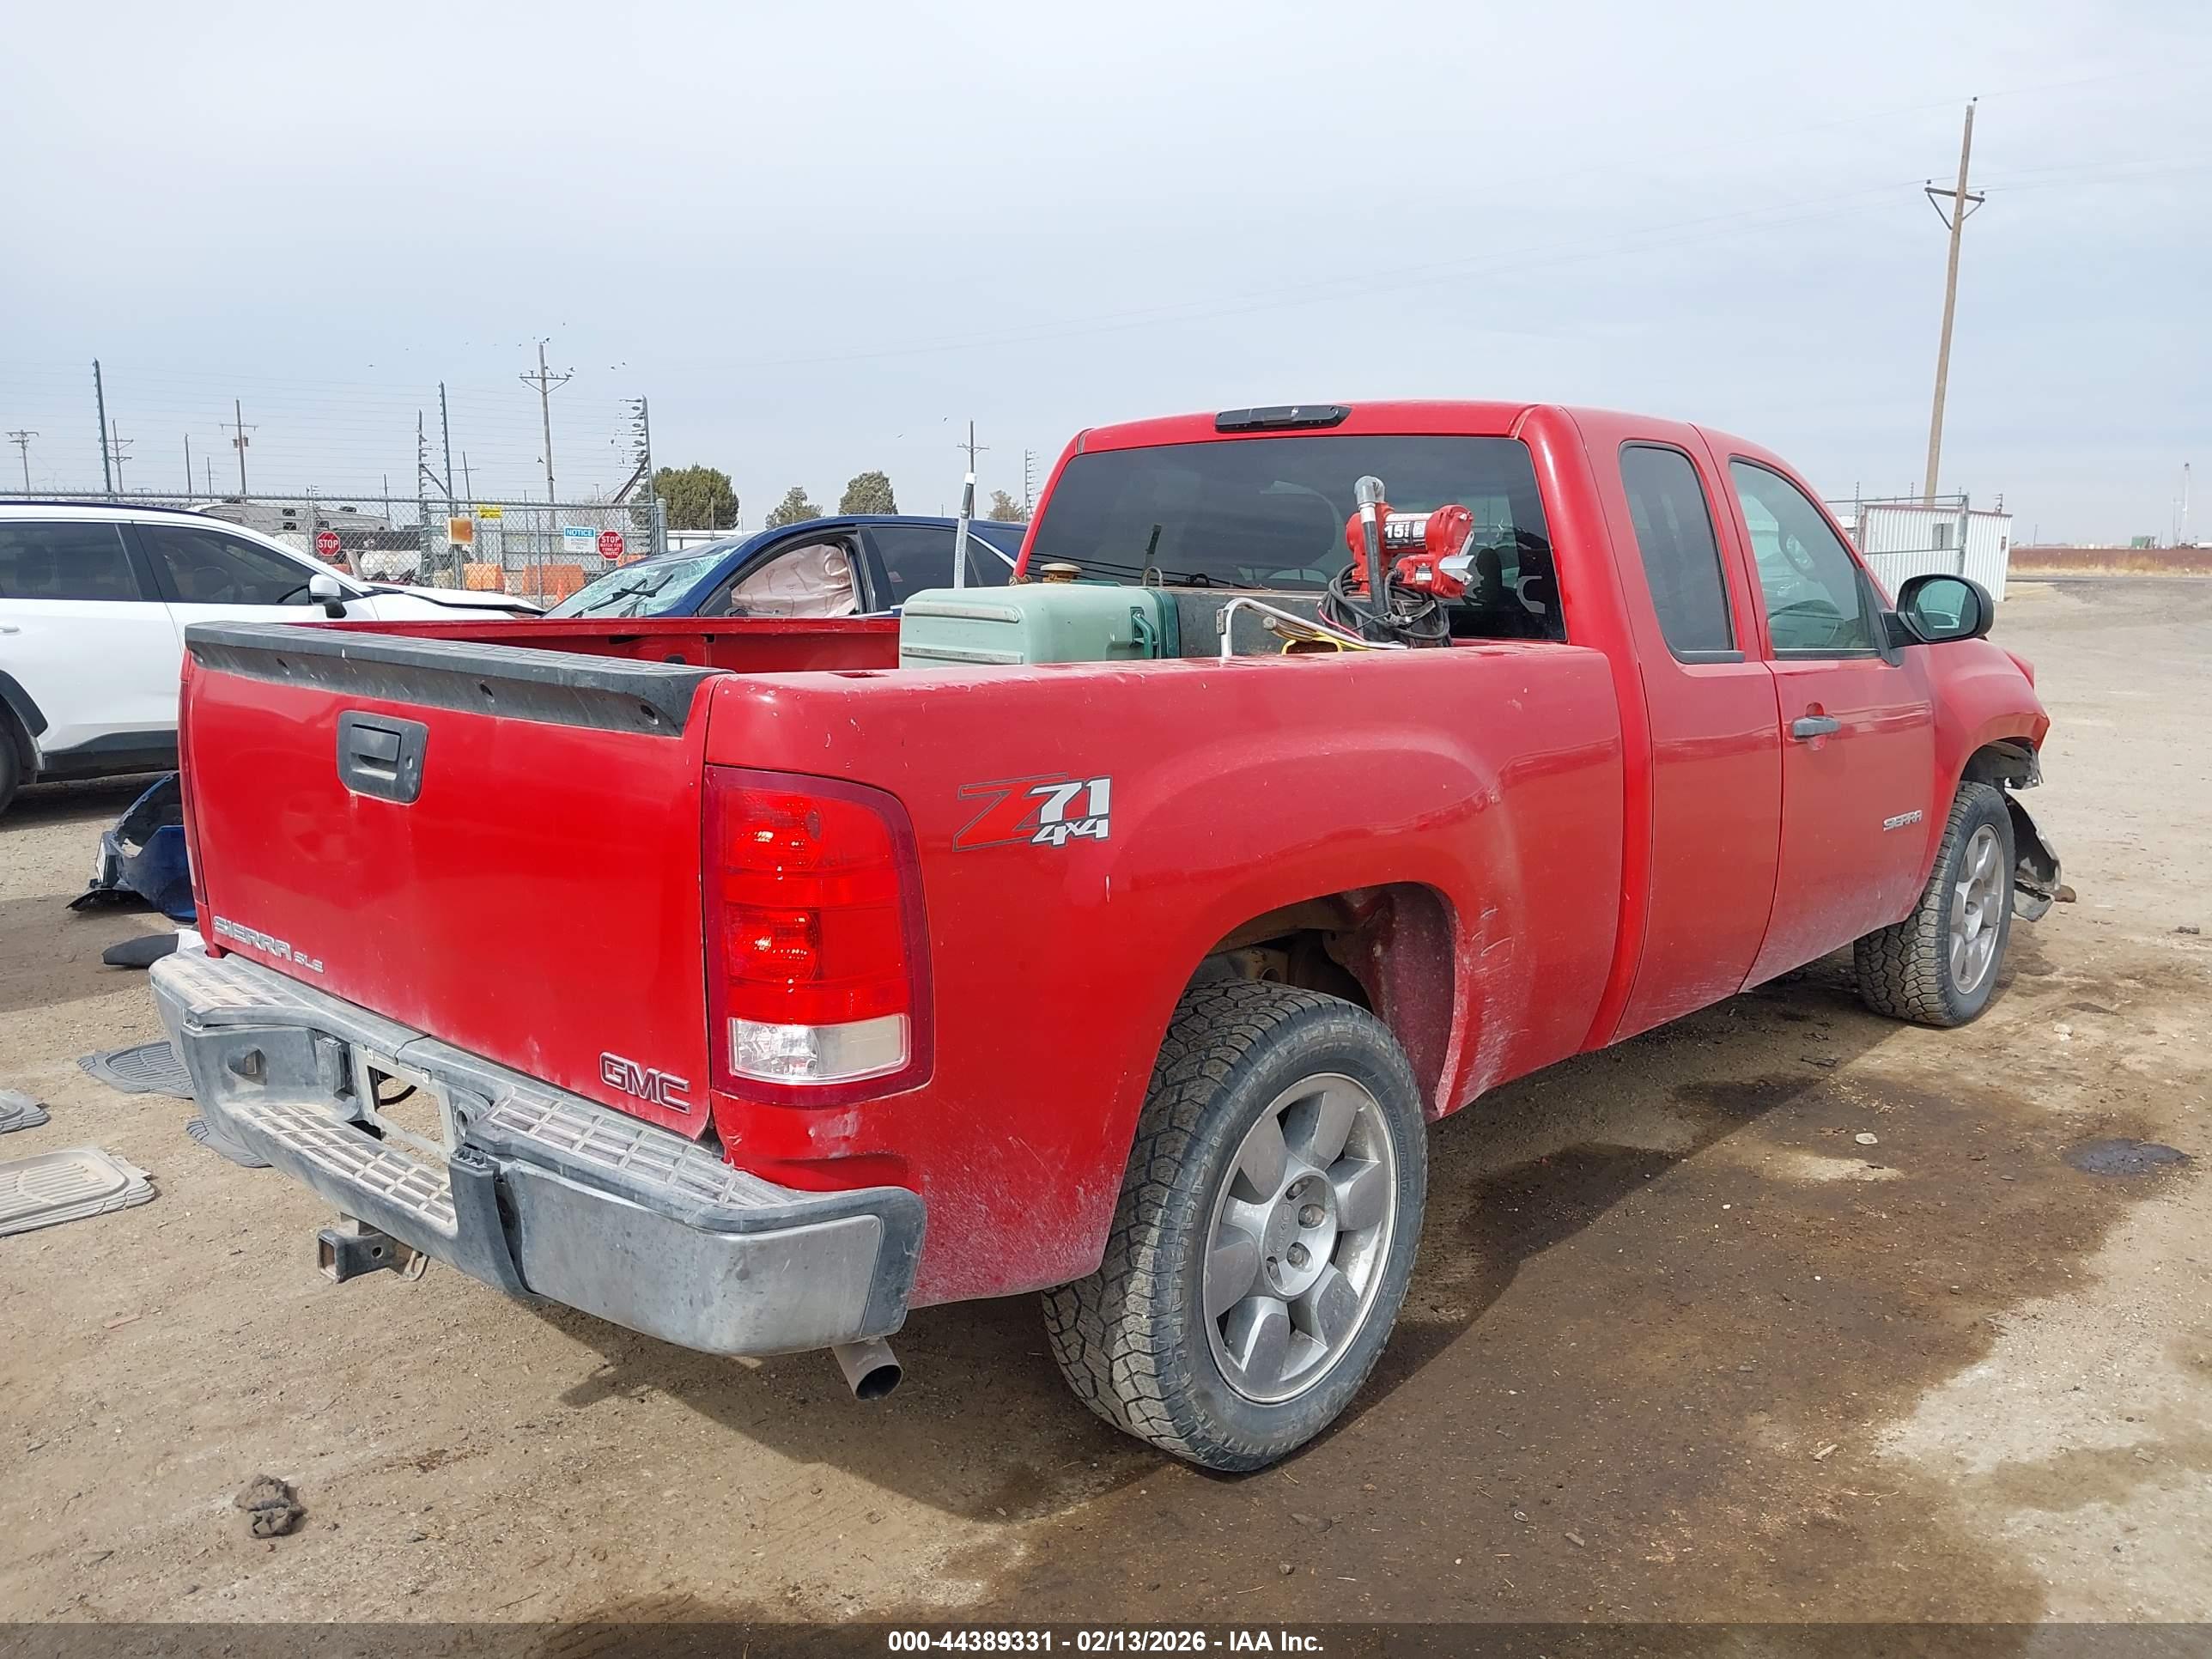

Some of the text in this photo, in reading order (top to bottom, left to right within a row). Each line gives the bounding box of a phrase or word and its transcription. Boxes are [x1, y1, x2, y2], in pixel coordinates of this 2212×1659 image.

[318, 539, 338, 549] STOP
[1384, 525, 1404, 538] 15
[952, 773, 1113, 852] Z71
[1883, 809, 1923, 832] SIERRA
[214, 915, 293, 962] SIERRA
[599, 1051, 691, 1115] GMC
